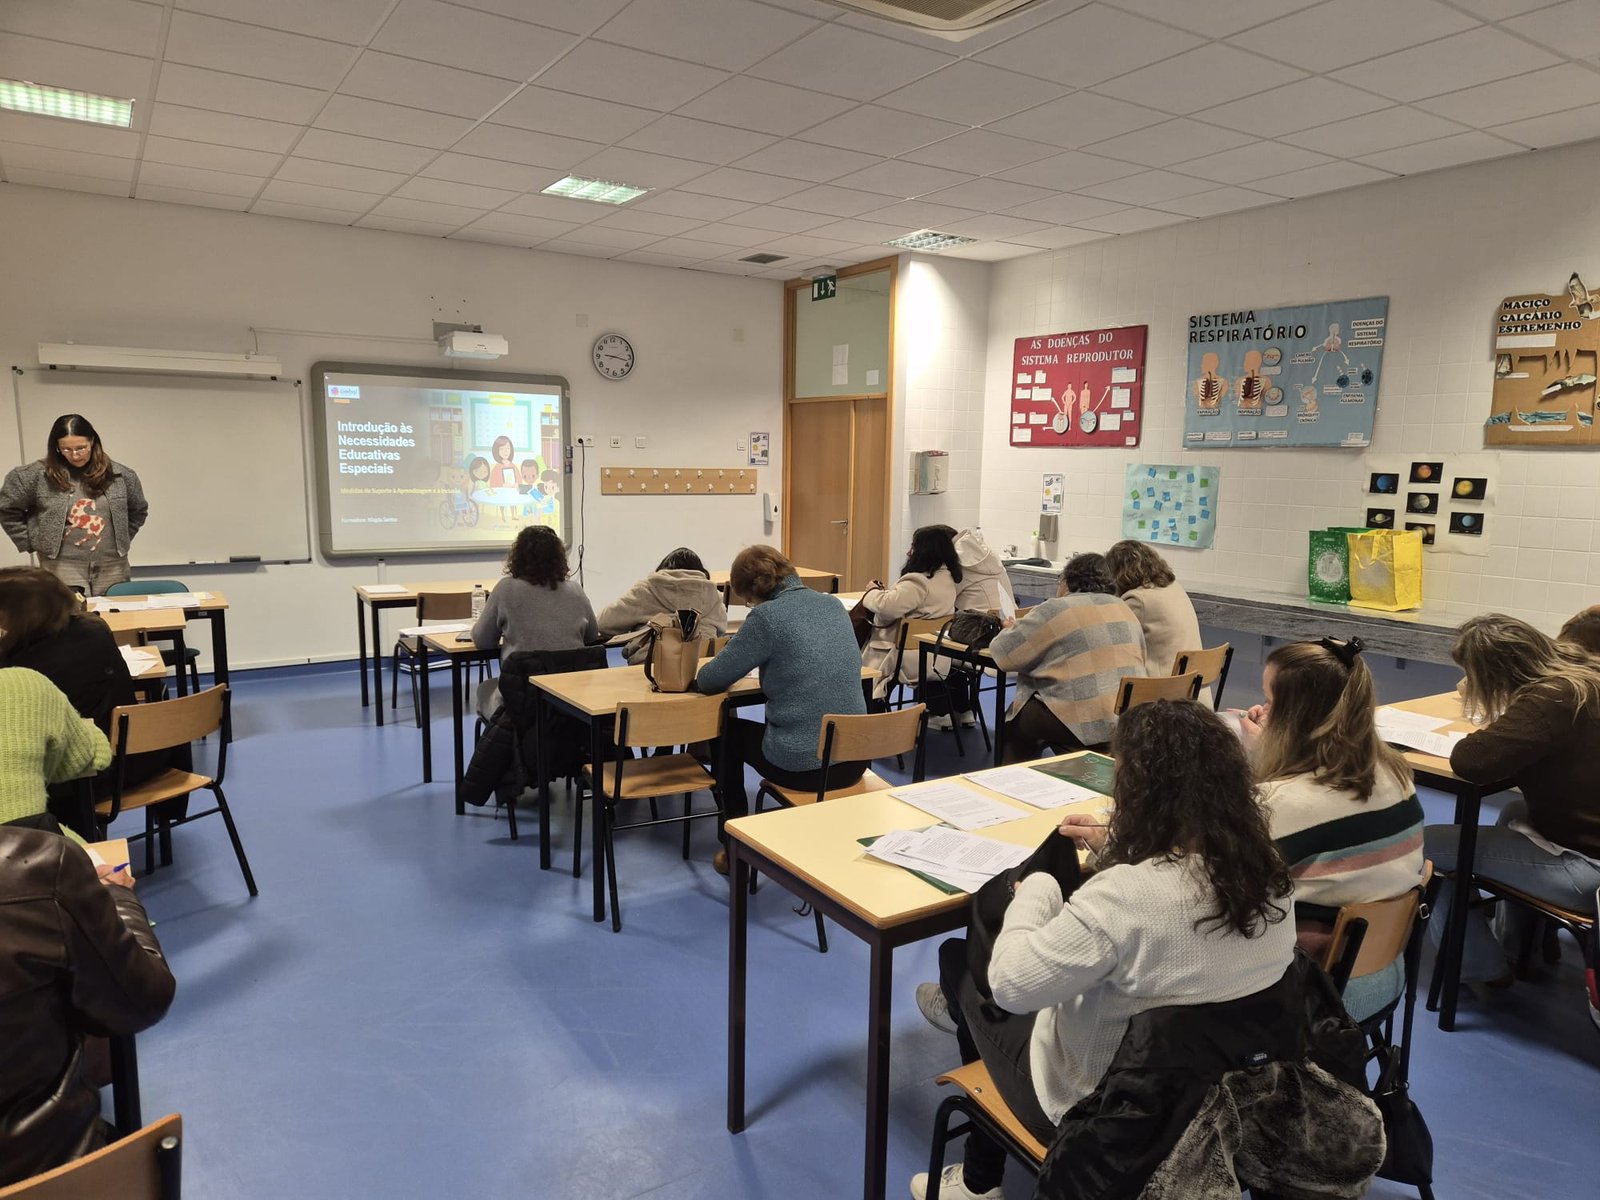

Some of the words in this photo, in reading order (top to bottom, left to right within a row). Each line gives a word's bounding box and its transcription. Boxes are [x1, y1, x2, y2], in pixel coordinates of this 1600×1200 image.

[1504, 298, 1550, 310] MACIÇO
[1190, 310, 1255, 328] SISTEMA
[1500, 310, 1562, 322] CALCÁRIO
[1190, 324, 1306, 343] RESPIRATÓRIO
[1498, 321, 1582, 333] ESTREMENHO
[1030, 340, 1042, 349] AS
[1048, 334, 1090, 348] DOENÇAS
[1098, 332, 1113, 344] DO
[1022, 354, 1058, 365] SISTEMA
[1066, 349, 1134, 364] REPRODUTOR
[338, 421, 398, 434] Introdução
[400, 422, 413, 433] às
[338, 435, 415, 447] Necessidades
[339, 449, 400, 460] Educativas
[340, 462, 394, 476] Especiais
